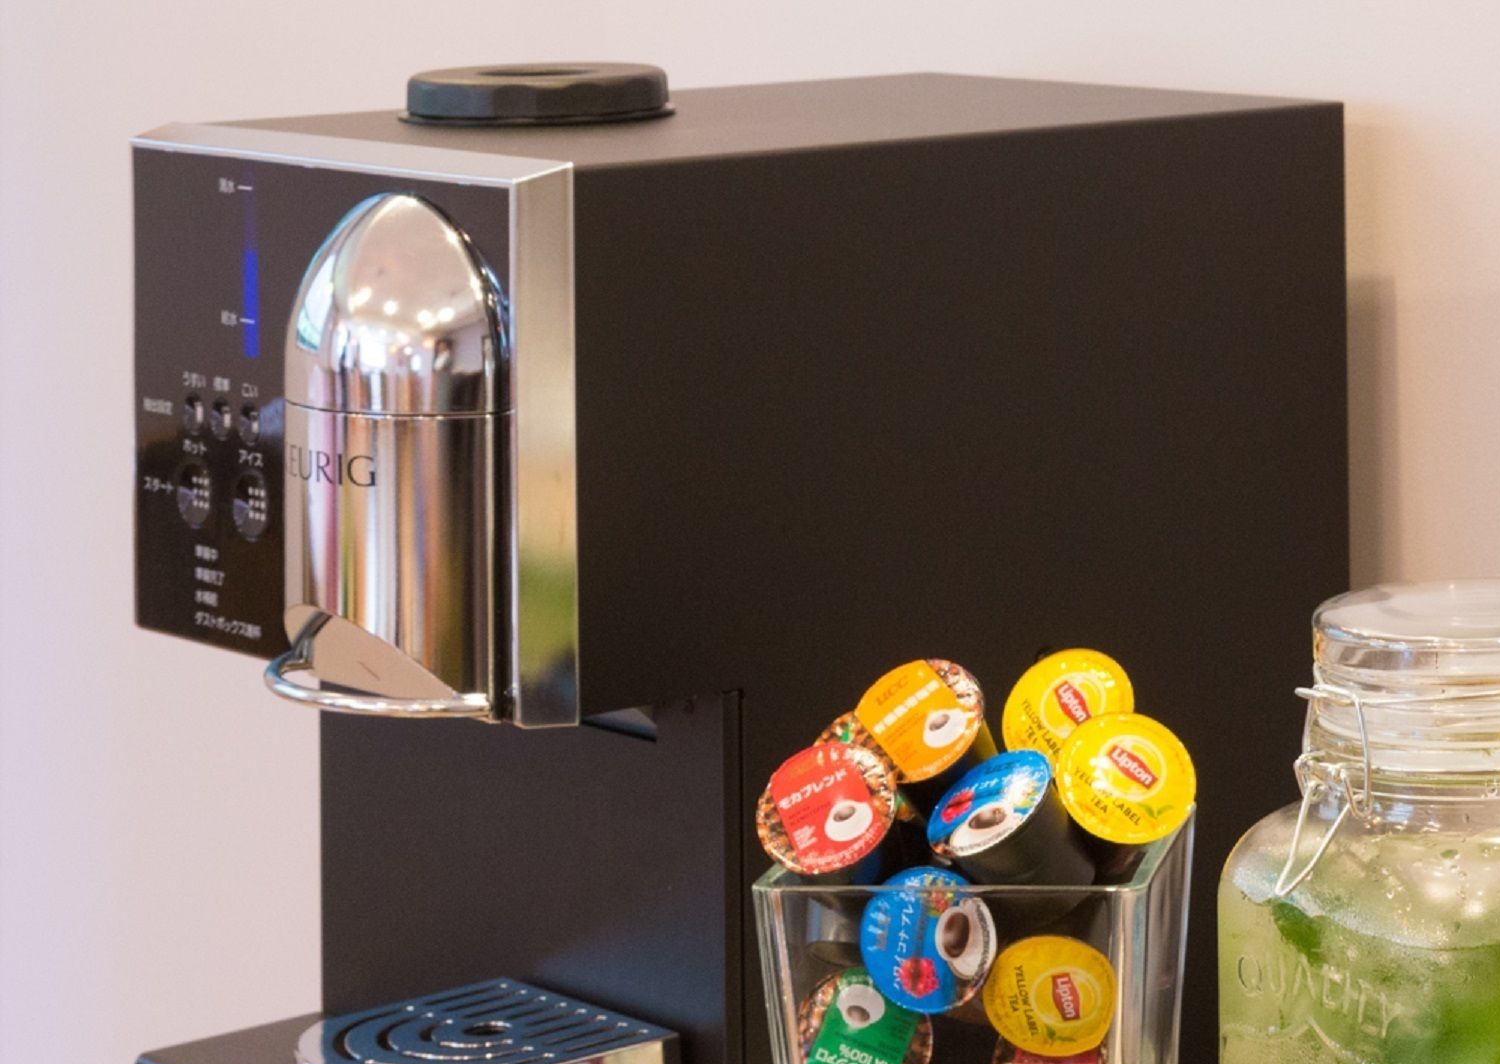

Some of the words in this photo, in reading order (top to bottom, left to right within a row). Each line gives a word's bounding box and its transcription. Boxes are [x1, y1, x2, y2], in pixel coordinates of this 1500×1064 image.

[238, 448, 264, 468] アイス
[288, 443, 377, 488] EURIG
[1057, 683, 1088, 723] Lipton
[1042, 730, 1061, 756] LABE
[1111, 747, 1154, 786] Lipton
[778, 768, 848, 811] モカブレンド
[1091, 795, 1109, 814] TEA
[1112, 798, 1142, 827] LABEL
[1014, 965, 1031, 1006] YELLOW
[1024, 1008, 1039, 1036] LABEL
[1055, 975, 1077, 1019] Lipton
